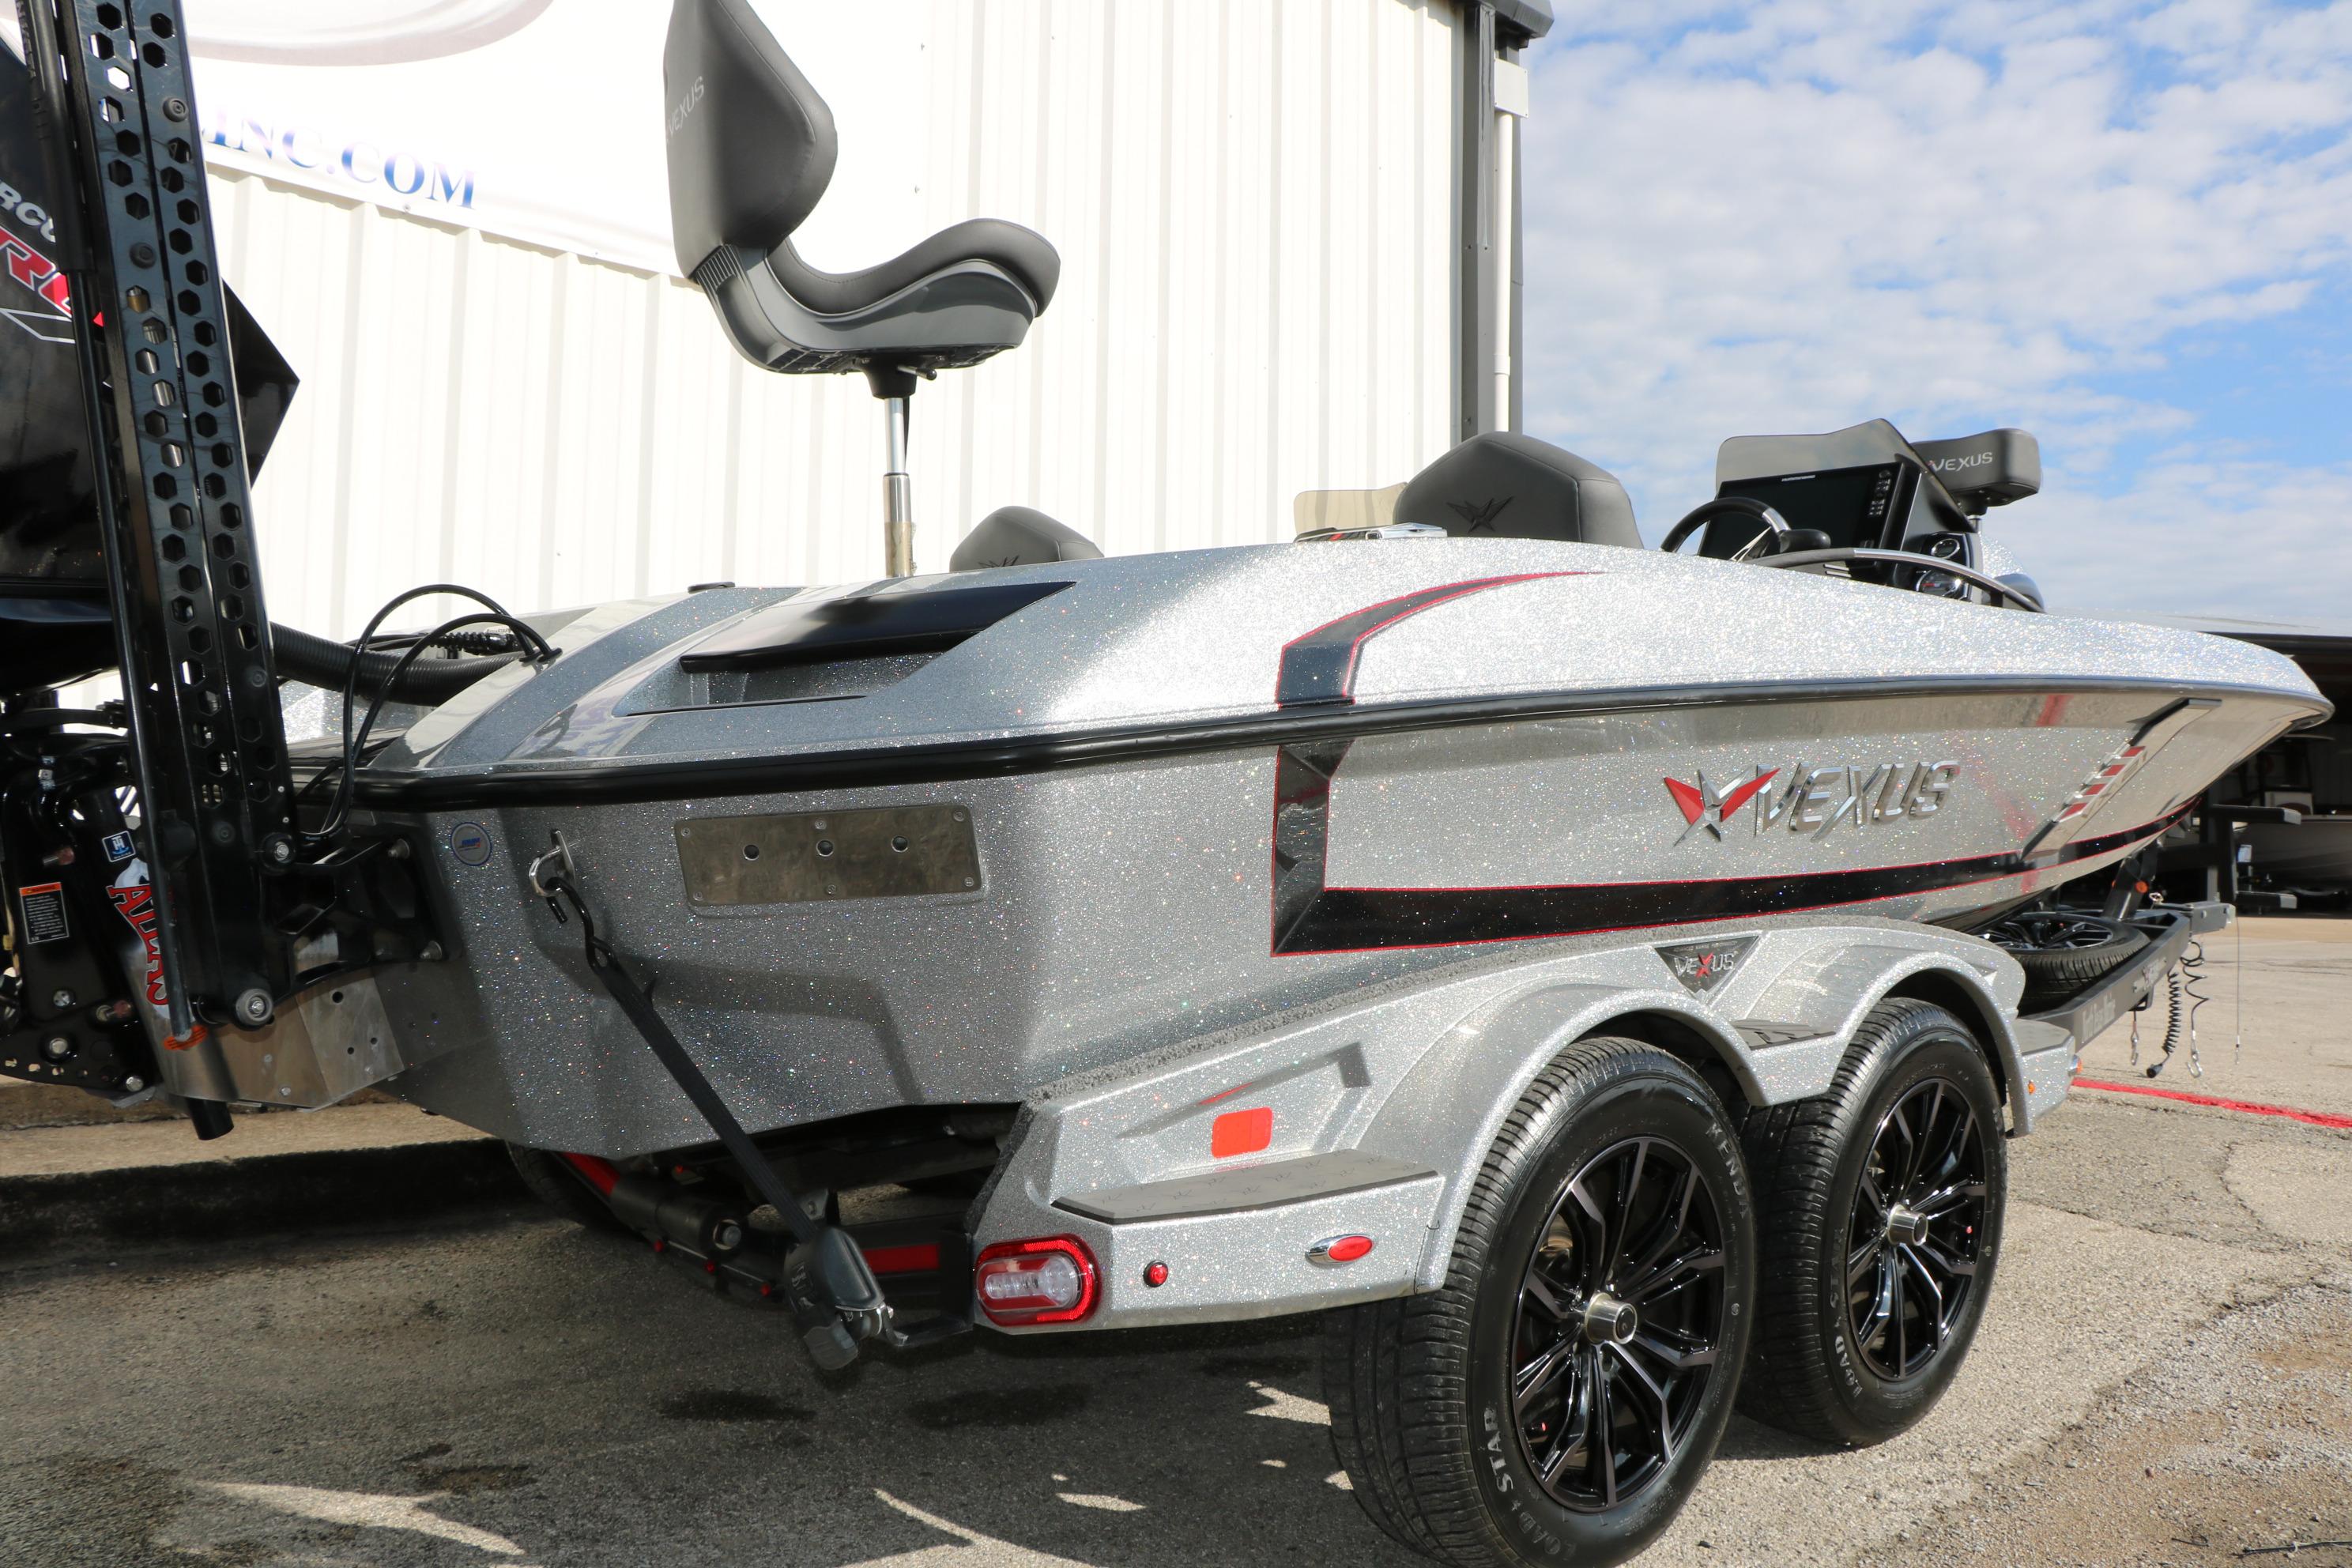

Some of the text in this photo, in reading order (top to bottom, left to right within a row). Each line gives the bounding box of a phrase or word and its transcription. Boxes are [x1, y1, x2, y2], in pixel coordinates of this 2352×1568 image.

[669, 75, 704, 138] VEXUS
[201, 106, 475, 209] INC.COM
[1932, 451, 1993, 472] VEXUS
[1753, 760, 1962, 842] VEXUS
[1673, 951, 1736, 978] VEXUS
[1705, 1121, 1751, 1220] KENDA
[1483, 1406, 1514, 1493] STAR
